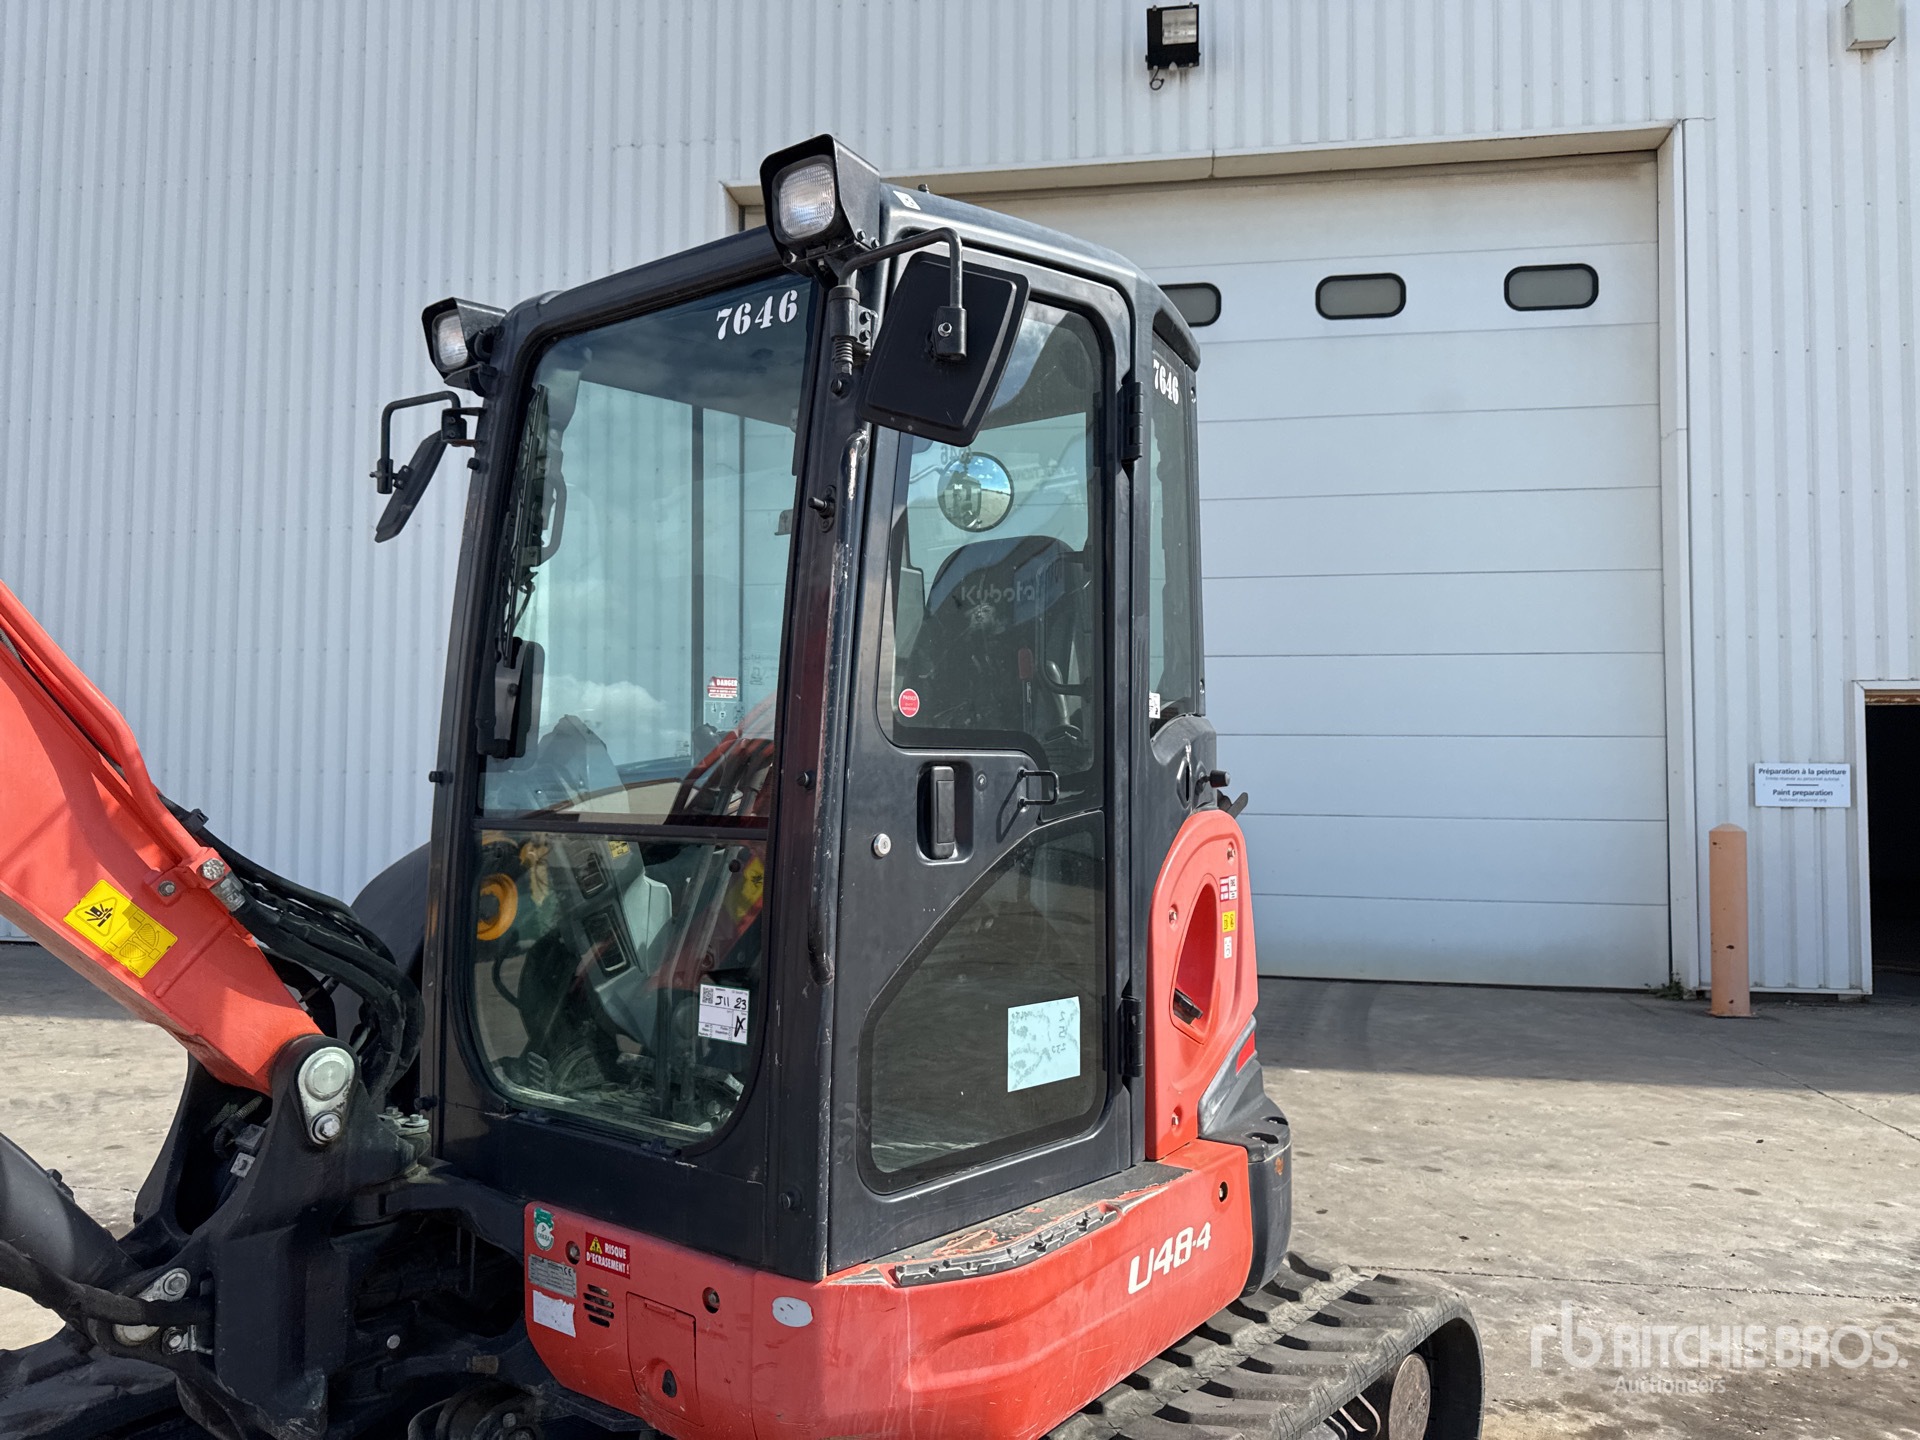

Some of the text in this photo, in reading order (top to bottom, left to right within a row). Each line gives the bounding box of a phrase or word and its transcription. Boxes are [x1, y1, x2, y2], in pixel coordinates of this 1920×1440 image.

[716, 289, 798, 340] 7646
[1153, 358, 1179, 405] 7646
[716, 678, 738, 687] DANGER
[1758, 767, 1800, 776] Préparation
[1816, 768, 1847, 776] peinture
[1792, 789, 1833, 797] preparation
[734, 997, 747, 1010] 23
[604, 1242, 627, 1259] RISQUE
[1127, 1221, 1211, 1295] U48-4
[586, 1252, 626, 1273] D'ECRASEMENT
